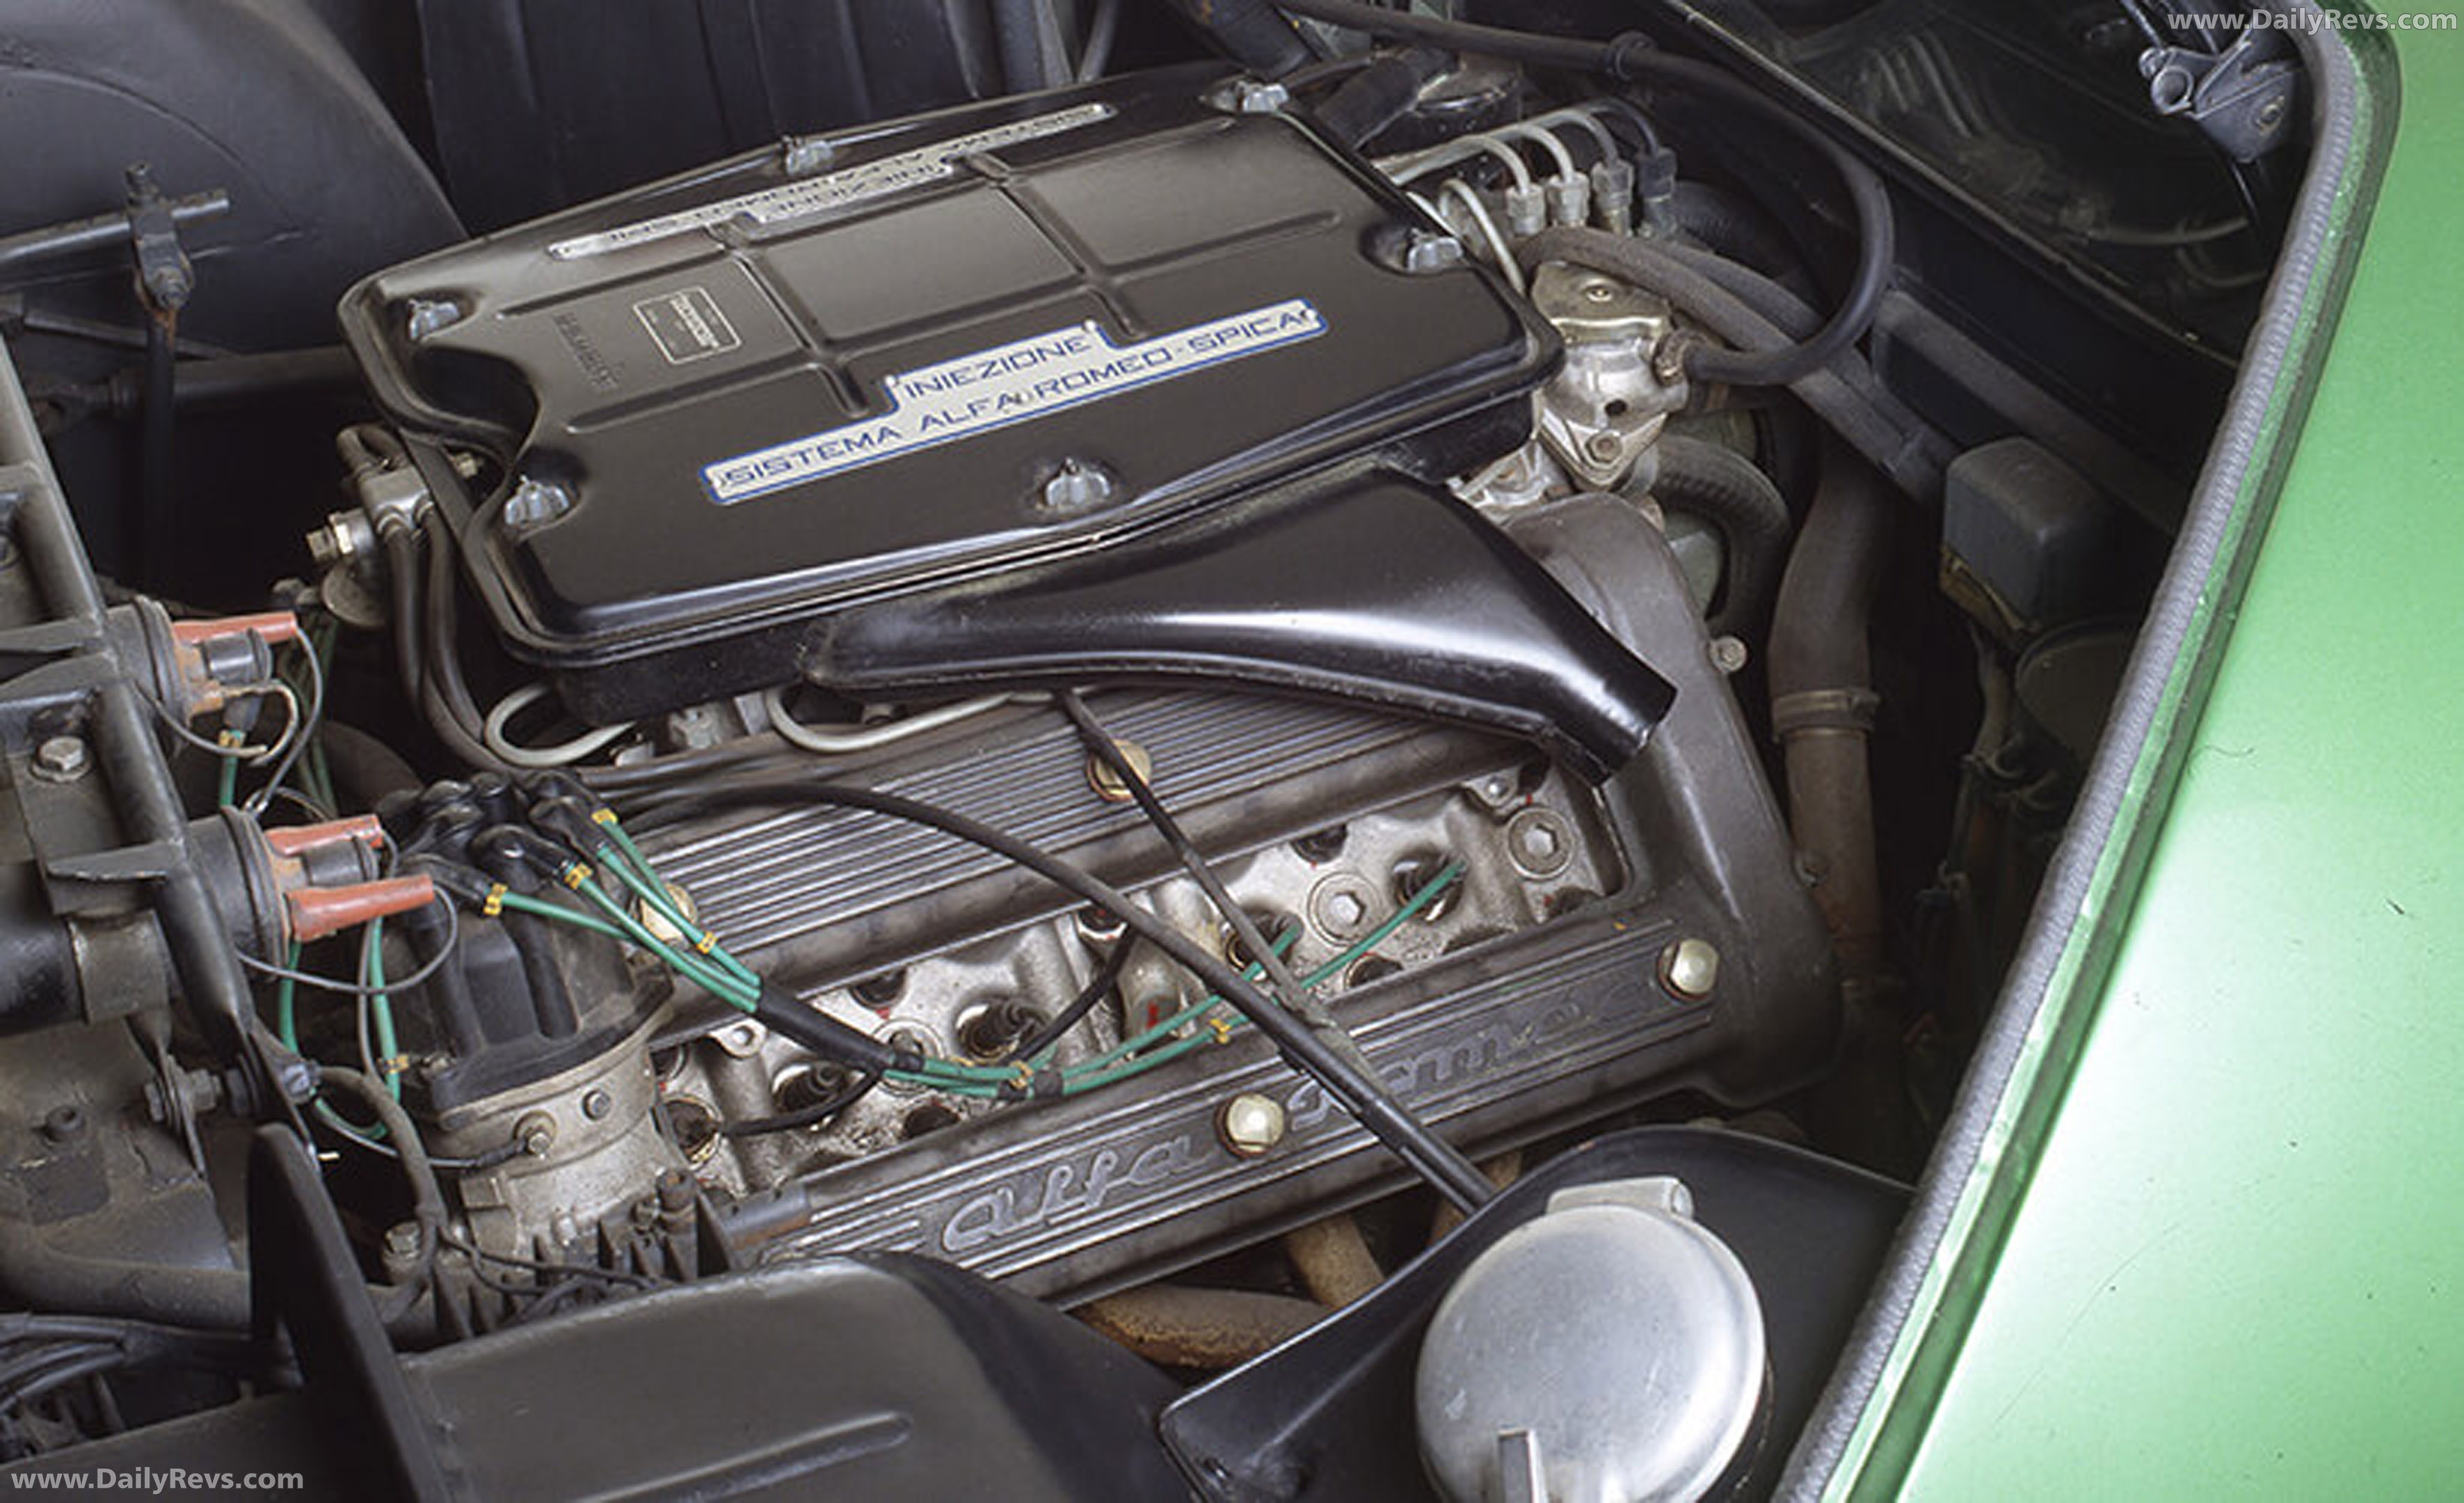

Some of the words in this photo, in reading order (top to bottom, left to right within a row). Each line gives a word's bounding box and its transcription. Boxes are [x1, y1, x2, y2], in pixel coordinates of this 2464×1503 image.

[904, 335, 1091, 399] INIEZIONE
[724, 426, 902, 486] SISTEMA
[920, 392, 1022, 431] ALFA
